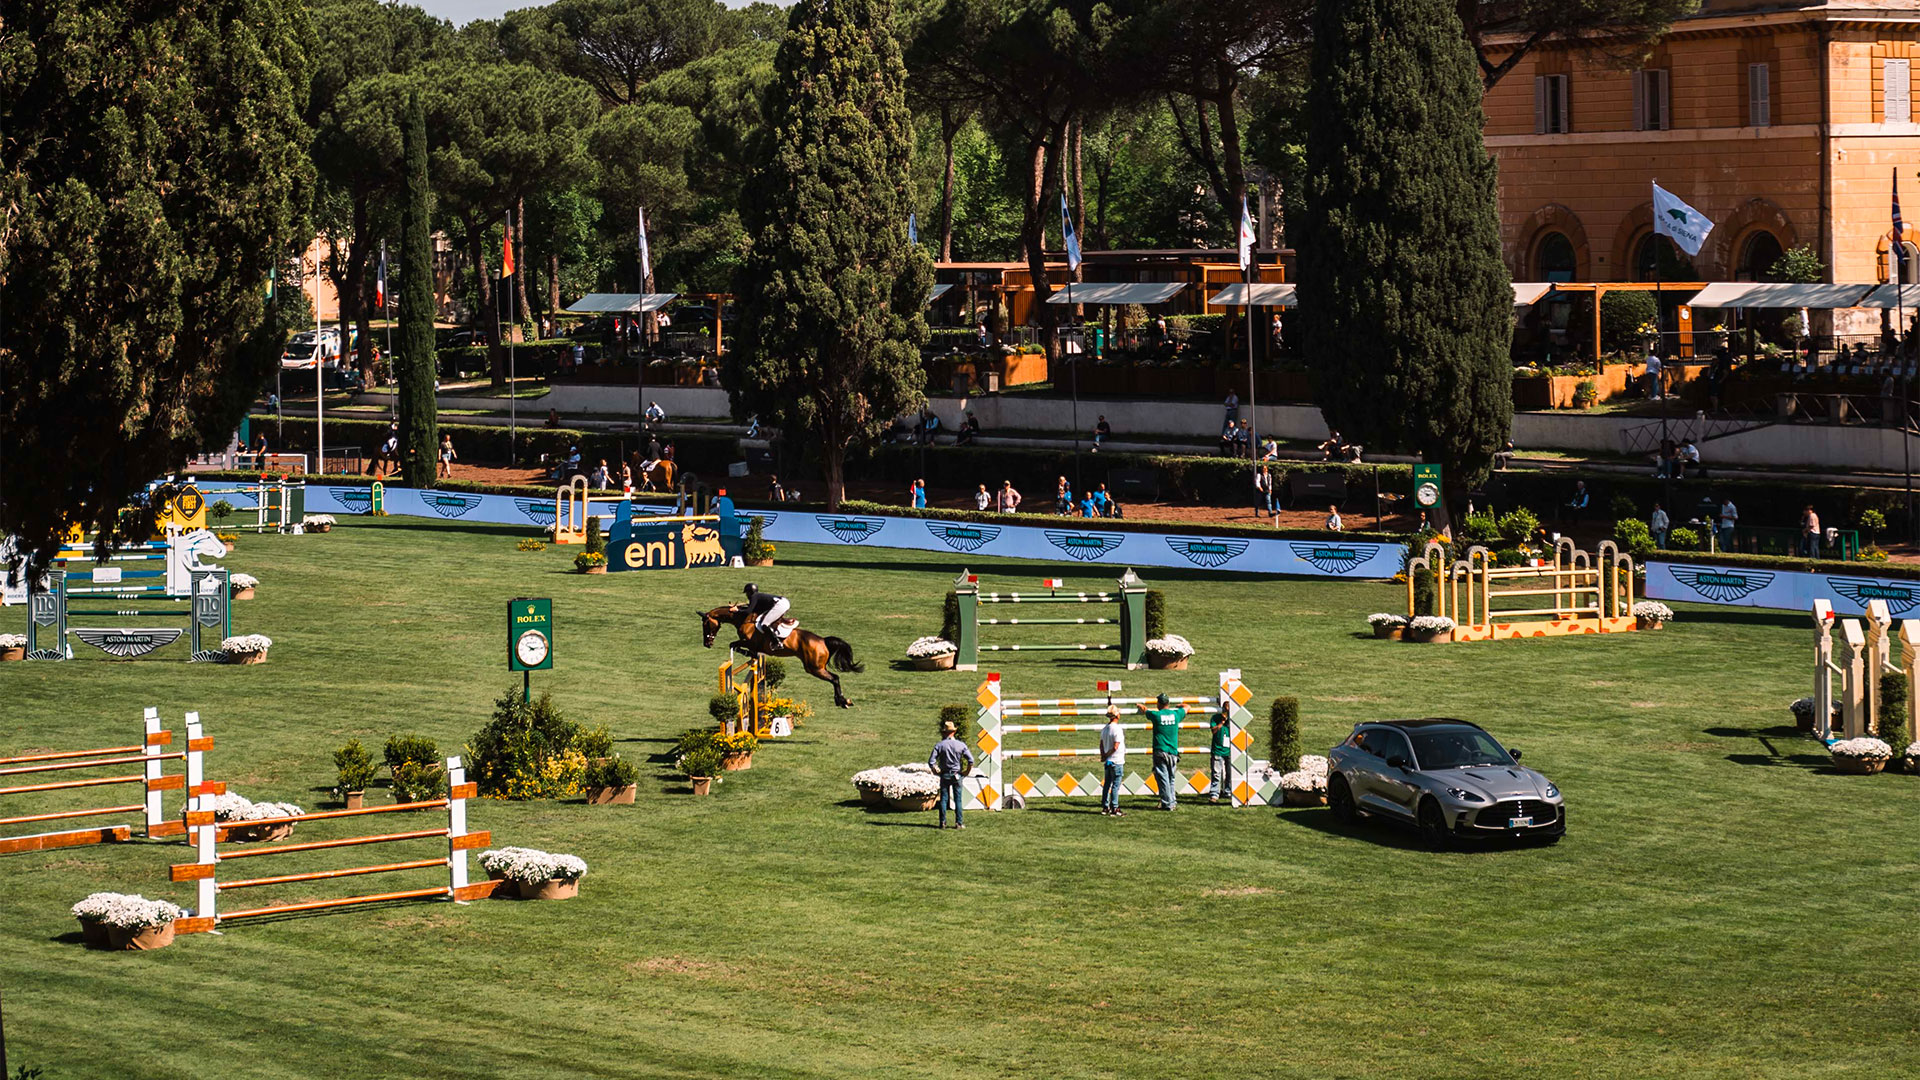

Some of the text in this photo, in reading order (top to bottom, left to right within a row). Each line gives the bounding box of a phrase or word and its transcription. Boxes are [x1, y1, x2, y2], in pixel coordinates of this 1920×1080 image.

[624, 532, 675, 568] eni
[1315, 550, 1354, 559] ASTON MARTIN
[1699, 575, 1745, 585] ASTON MARTIN
[1860, 587, 1910, 598] ASTON MARTIN
[517, 615, 546, 623] ROLEX
[106, 635, 152, 643] ASTON MARTIN
[775, 722, 780, 734] 6
